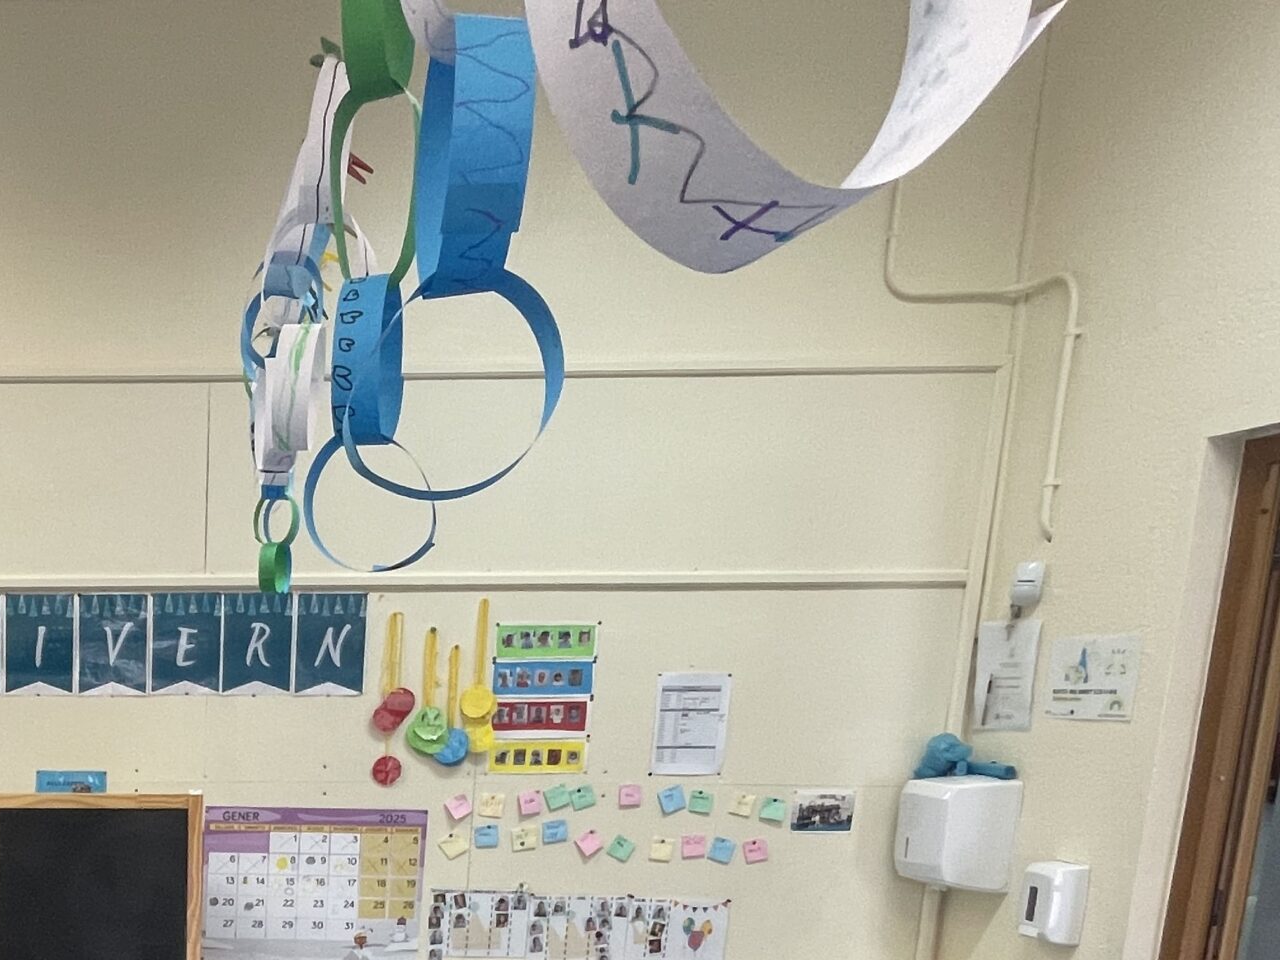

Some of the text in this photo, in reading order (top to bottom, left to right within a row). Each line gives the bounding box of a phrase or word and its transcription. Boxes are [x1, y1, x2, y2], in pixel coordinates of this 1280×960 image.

[222, 810, 407, 824] GENER 2025
[321, 835, 328, 843] 2
[352, 836, 358, 844] 3
[383, 836, 389, 844] 4
[229, 855, 236, 863] 6
[261, 855, 267, 863] 7
[290, 856, 296, 864] 8
[320, 856, 327, 865] 9
[347, 857, 357, 866] 10
[408, 858, 417, 866] 12
[226, 876, 416, 888] 13 14 15 16 17 18 19
[222, 898, 414, 909] 20 21 22 23 24 25 26
[223, 920, 354, 930] 27 28 29 30 31
